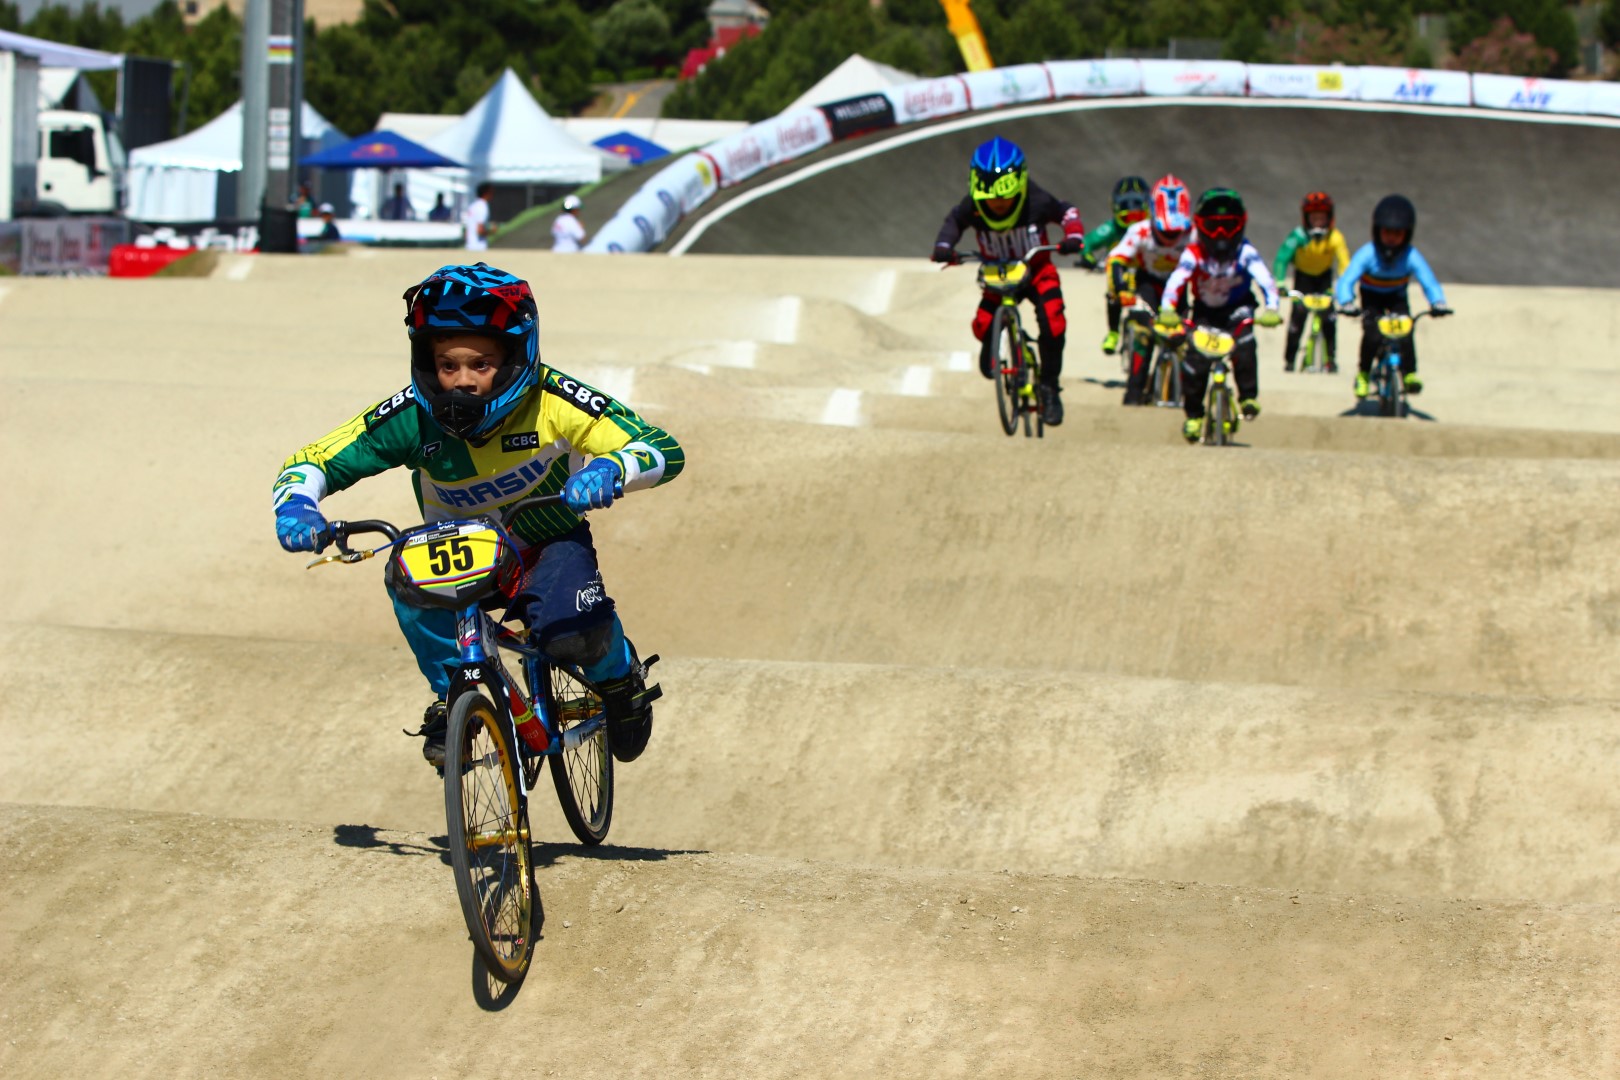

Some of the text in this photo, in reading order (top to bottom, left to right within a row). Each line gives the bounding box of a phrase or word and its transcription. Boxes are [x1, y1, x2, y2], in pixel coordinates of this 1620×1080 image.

[379, 385, 415, 415] CBC
[562, 380, 606, 411] CBC
[512, 434, 537, 447] CBC
[433, 459, 546, 508] BRASIL
[428, 536, 474, 576] 55
